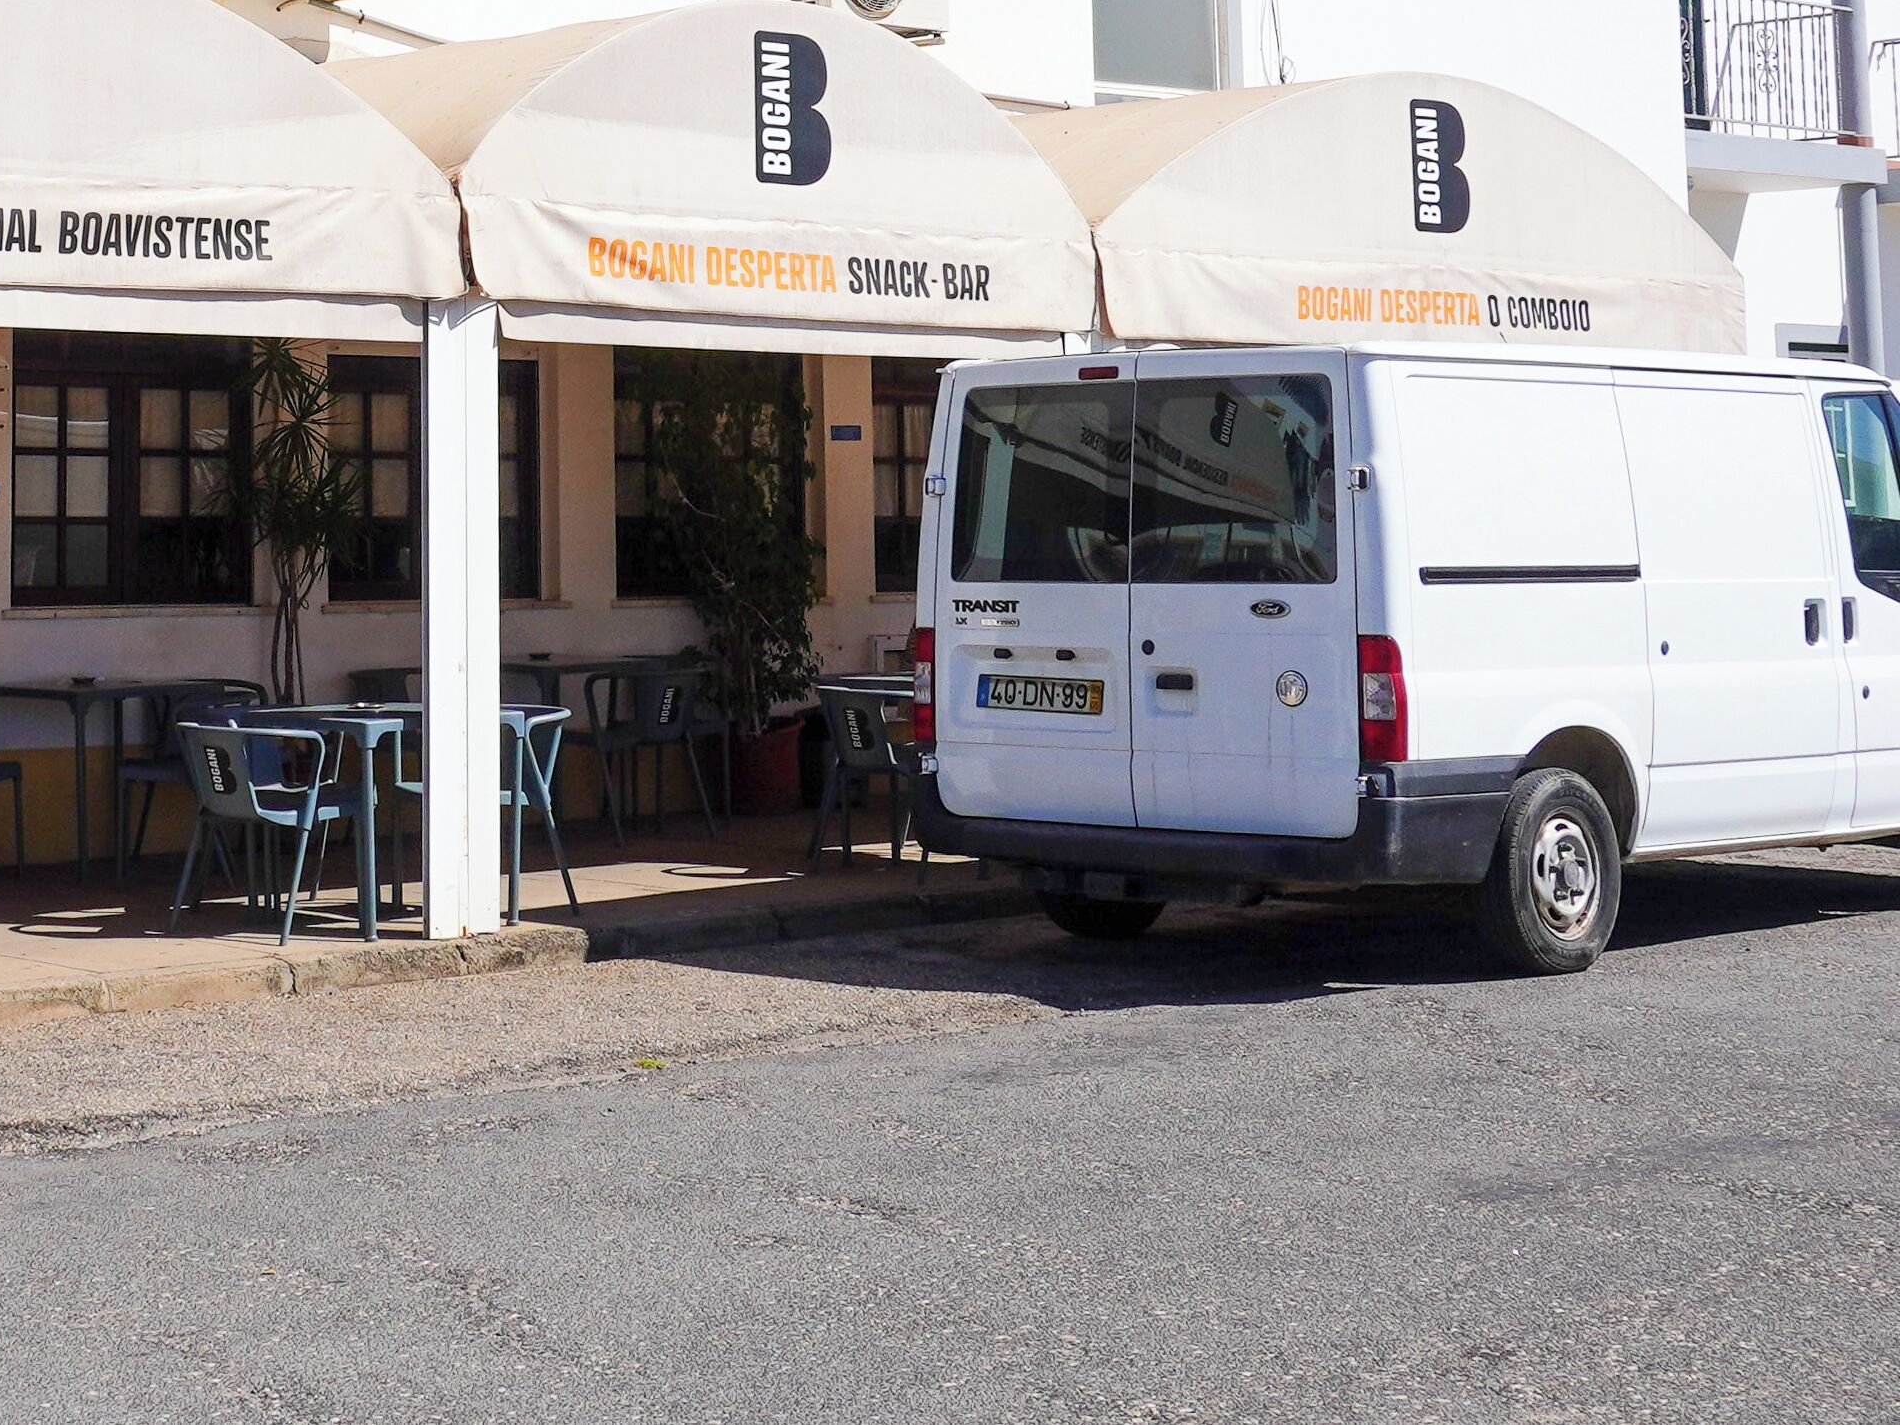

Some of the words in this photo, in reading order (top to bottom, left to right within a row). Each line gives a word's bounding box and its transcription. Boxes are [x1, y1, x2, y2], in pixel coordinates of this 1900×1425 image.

[761, 40, 792, 175] BOGANI
[1414, 107, 1442, 225] BOGANI
[59, 210, 273, 262] BOAVISTENSE
[588, 237, 695, 284] BOGANI
[706, 246, 837, 293] DESPERTA
[1297, 285, 1372, 322] BOGANI
[1379, 289, 1481, 326] DESPERTA
[1487, 294, 1501, 327] O
[1507, 296, 1591, 332] COMBOIO
[952, 599, 1020, 614] TRANSIT
[845, 709, 863, 748] BOGANI
[206, 748, 225, 792] BOGANI
